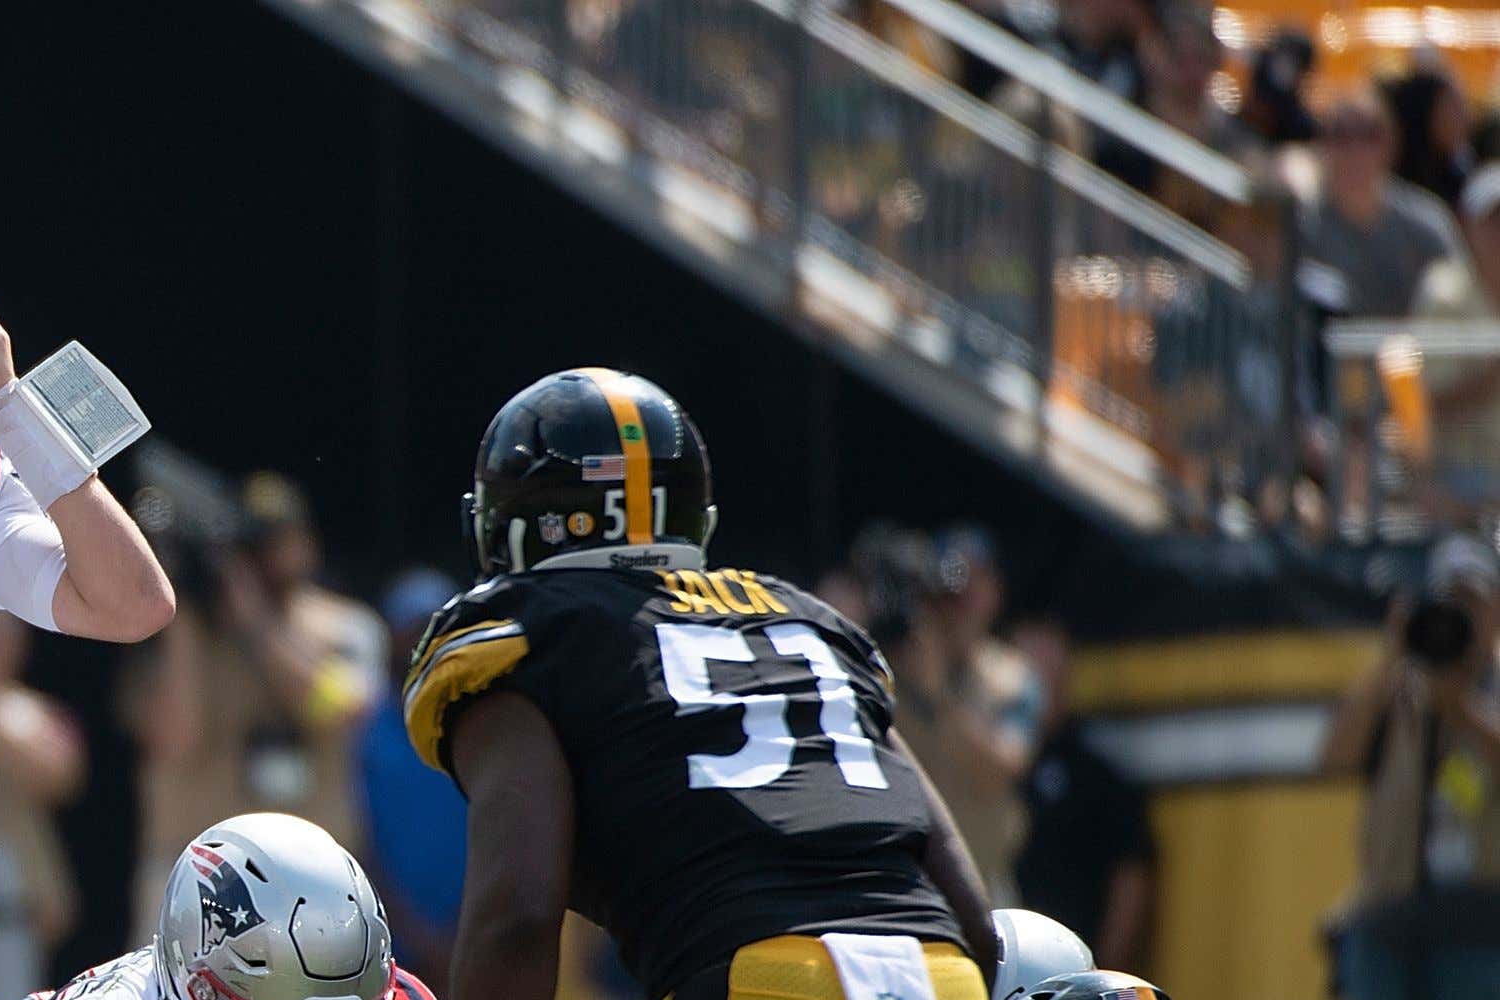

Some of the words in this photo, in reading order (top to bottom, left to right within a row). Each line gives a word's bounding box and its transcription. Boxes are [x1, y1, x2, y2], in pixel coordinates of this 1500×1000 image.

[603, 487, 668, 541] 51
[609, 552, 669, 567] Steelers
[655, 622, 889, 790] 51
